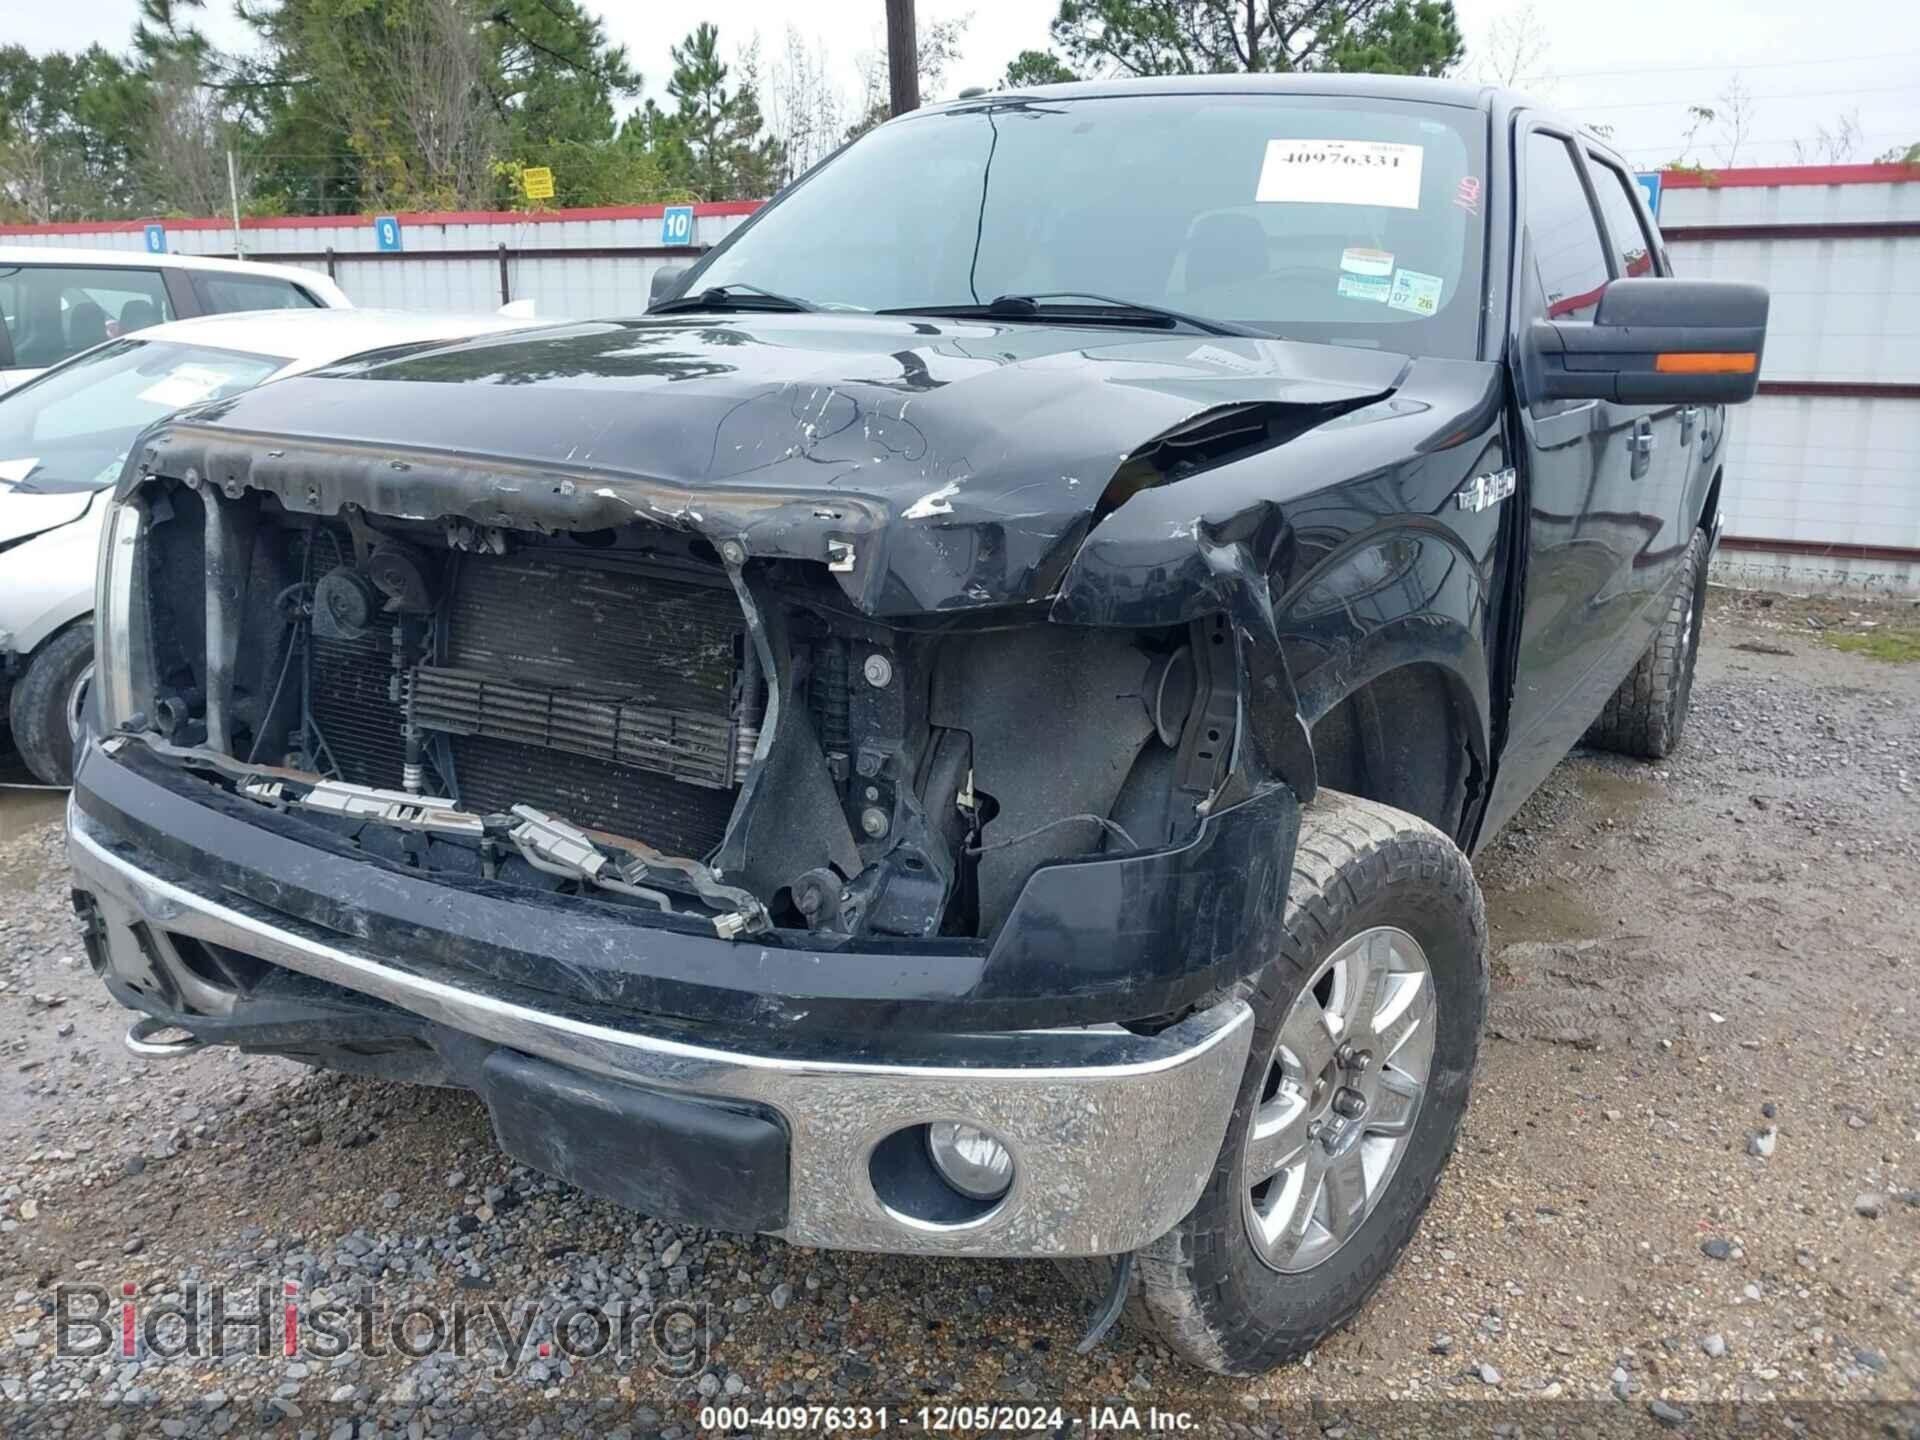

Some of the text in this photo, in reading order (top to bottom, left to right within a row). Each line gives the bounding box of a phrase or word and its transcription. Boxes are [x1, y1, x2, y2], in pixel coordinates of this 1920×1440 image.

[1281, 152, 1400, 167] 40976331
[383, 223, 394, 245] 9
[667, 214, 687, 237] 10
